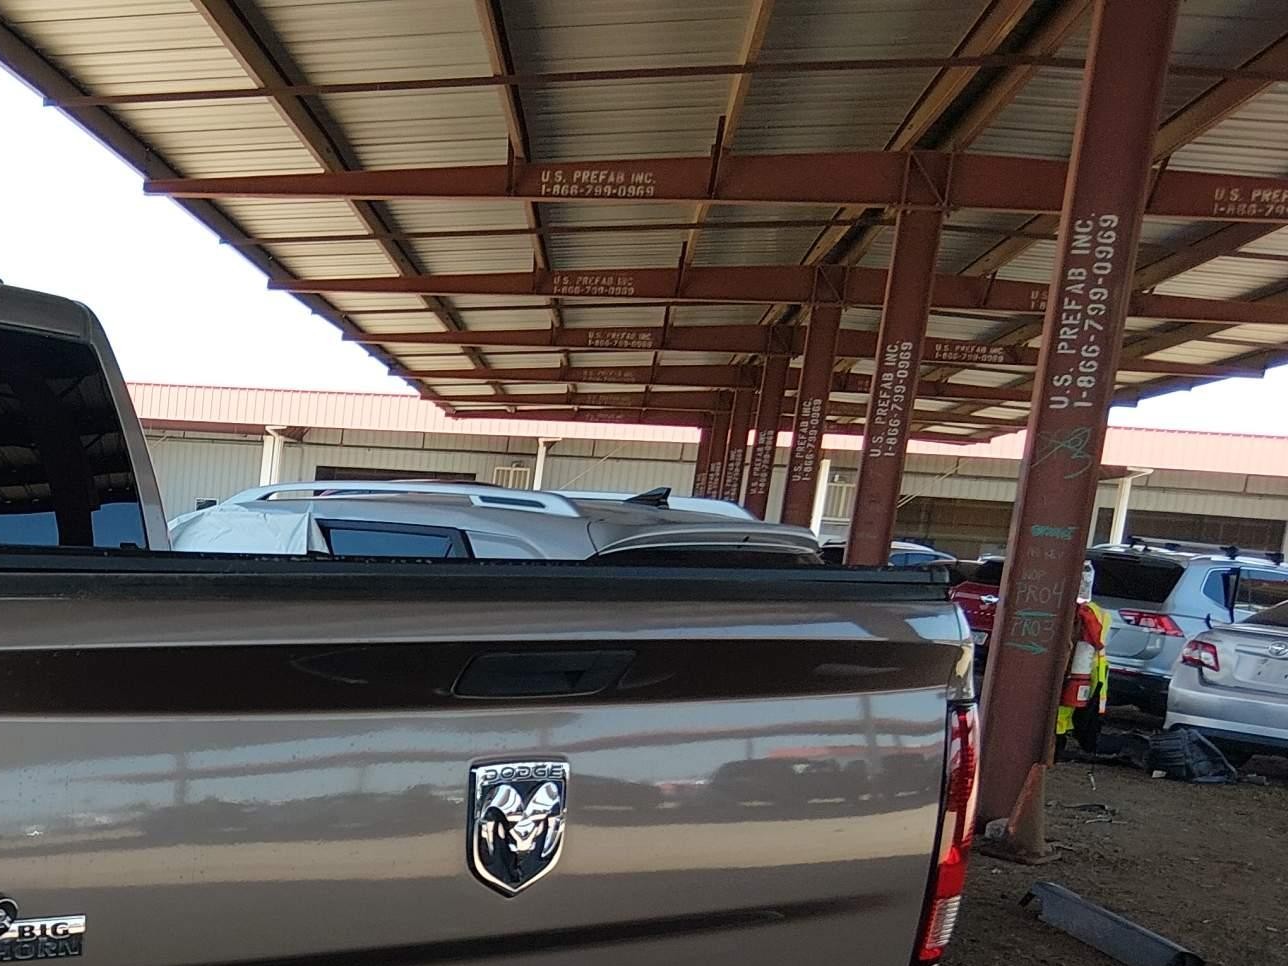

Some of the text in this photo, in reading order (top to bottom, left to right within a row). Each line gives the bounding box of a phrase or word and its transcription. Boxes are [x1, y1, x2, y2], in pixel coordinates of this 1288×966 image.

[573, 170, 625, 184] PREFAB
[631, 173, 656, 184] INC.
[1049, 212, 1095, 409] U.S. PREFAB INC.
[1073, 214, 1119, 408] 1-866-799-0969
[869, 340, 900, 458] U.S. PREFAB INC.
[884, 342, 913, 457] 1-866-799-0969
[795, 421, 809, 458] PREFAB
[484, 765, 563, 781] DODGE
[17, 922, 70, 940] BIG
